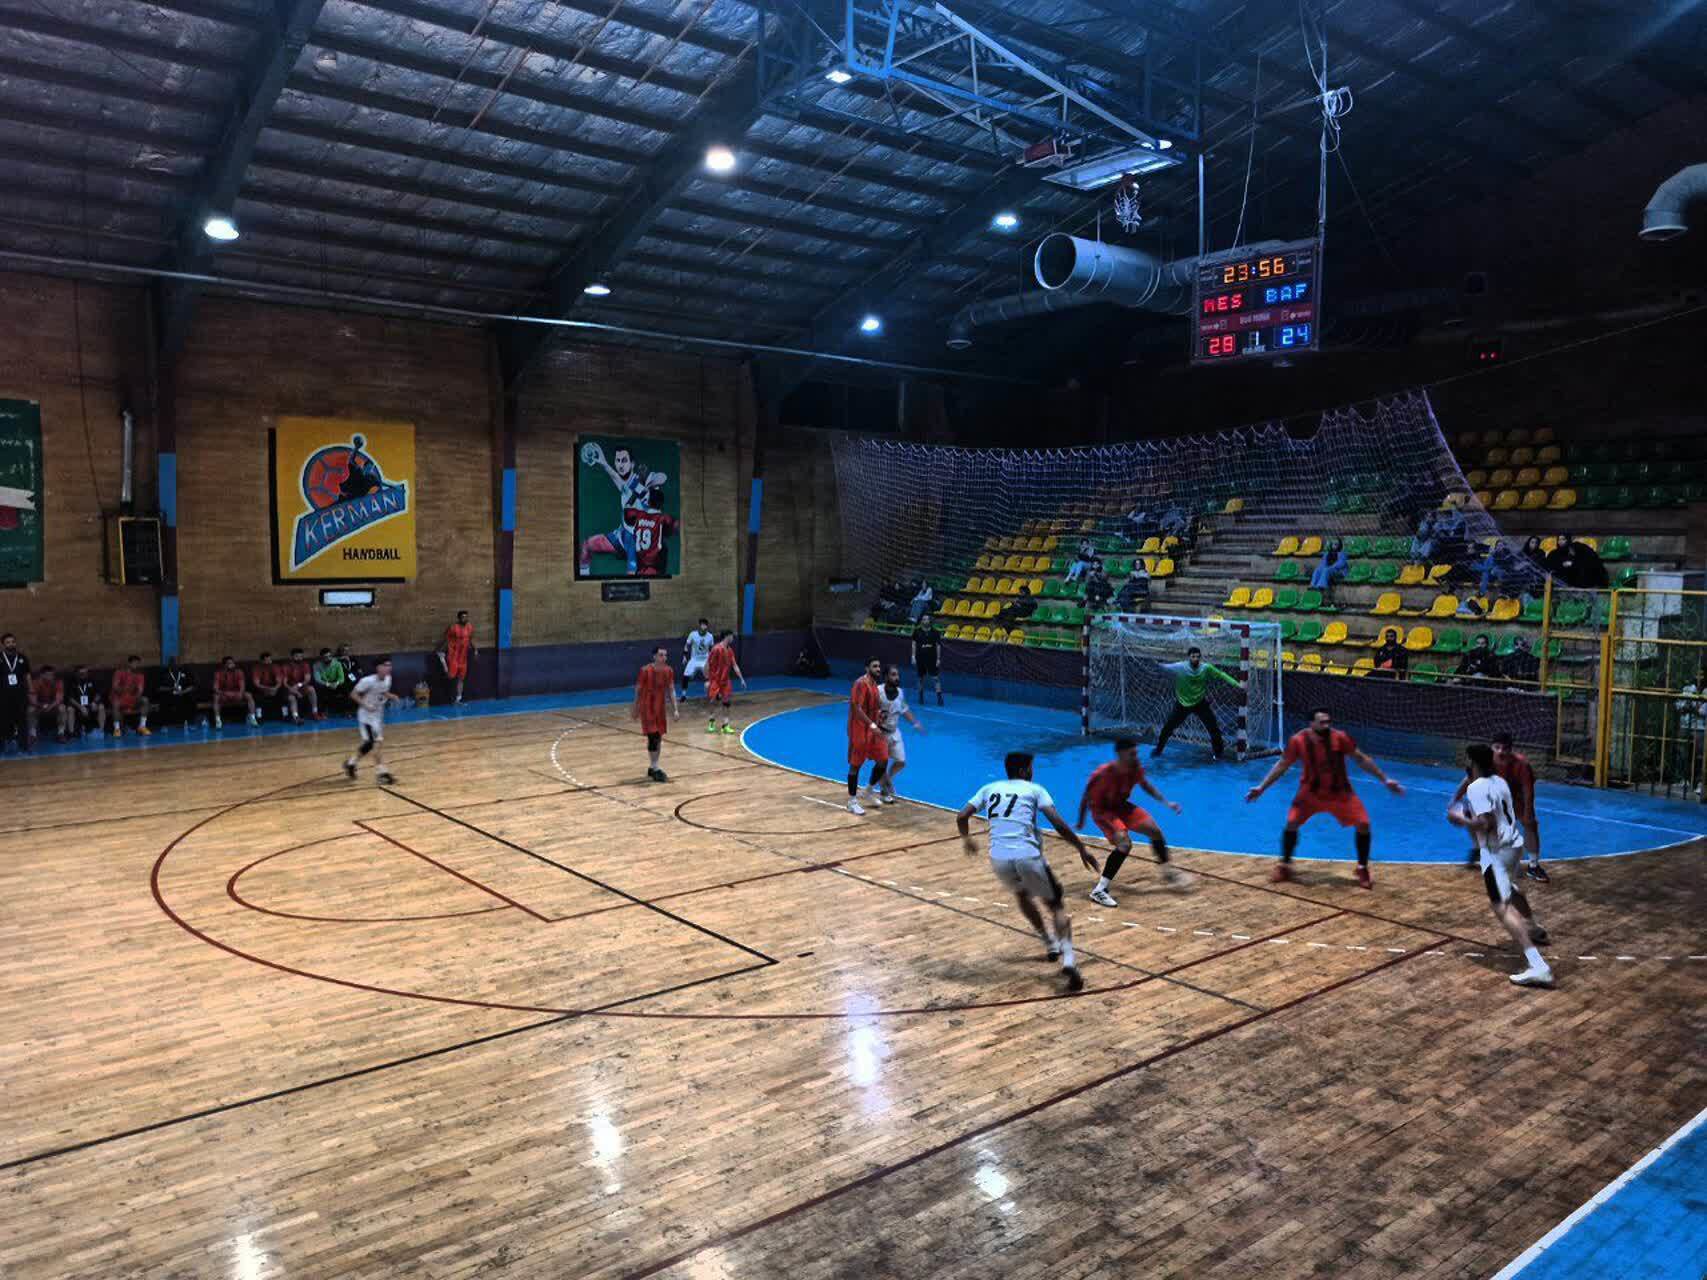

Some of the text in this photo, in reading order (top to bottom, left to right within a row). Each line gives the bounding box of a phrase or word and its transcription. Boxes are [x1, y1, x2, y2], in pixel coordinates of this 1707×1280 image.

[1223, 257, 1285, 284] 23:56
[1266, 283, 1307, 303] BAF
[1209, 335, 1233, 355] 28
[1282, 324, 1309, 345] 24
[304, 490, 401, 551] KERMAN
[635, 528, 652, 553] 19
[342, 548, 401, 561] HANDBALL
[988, 793, 1018, 818] 27
